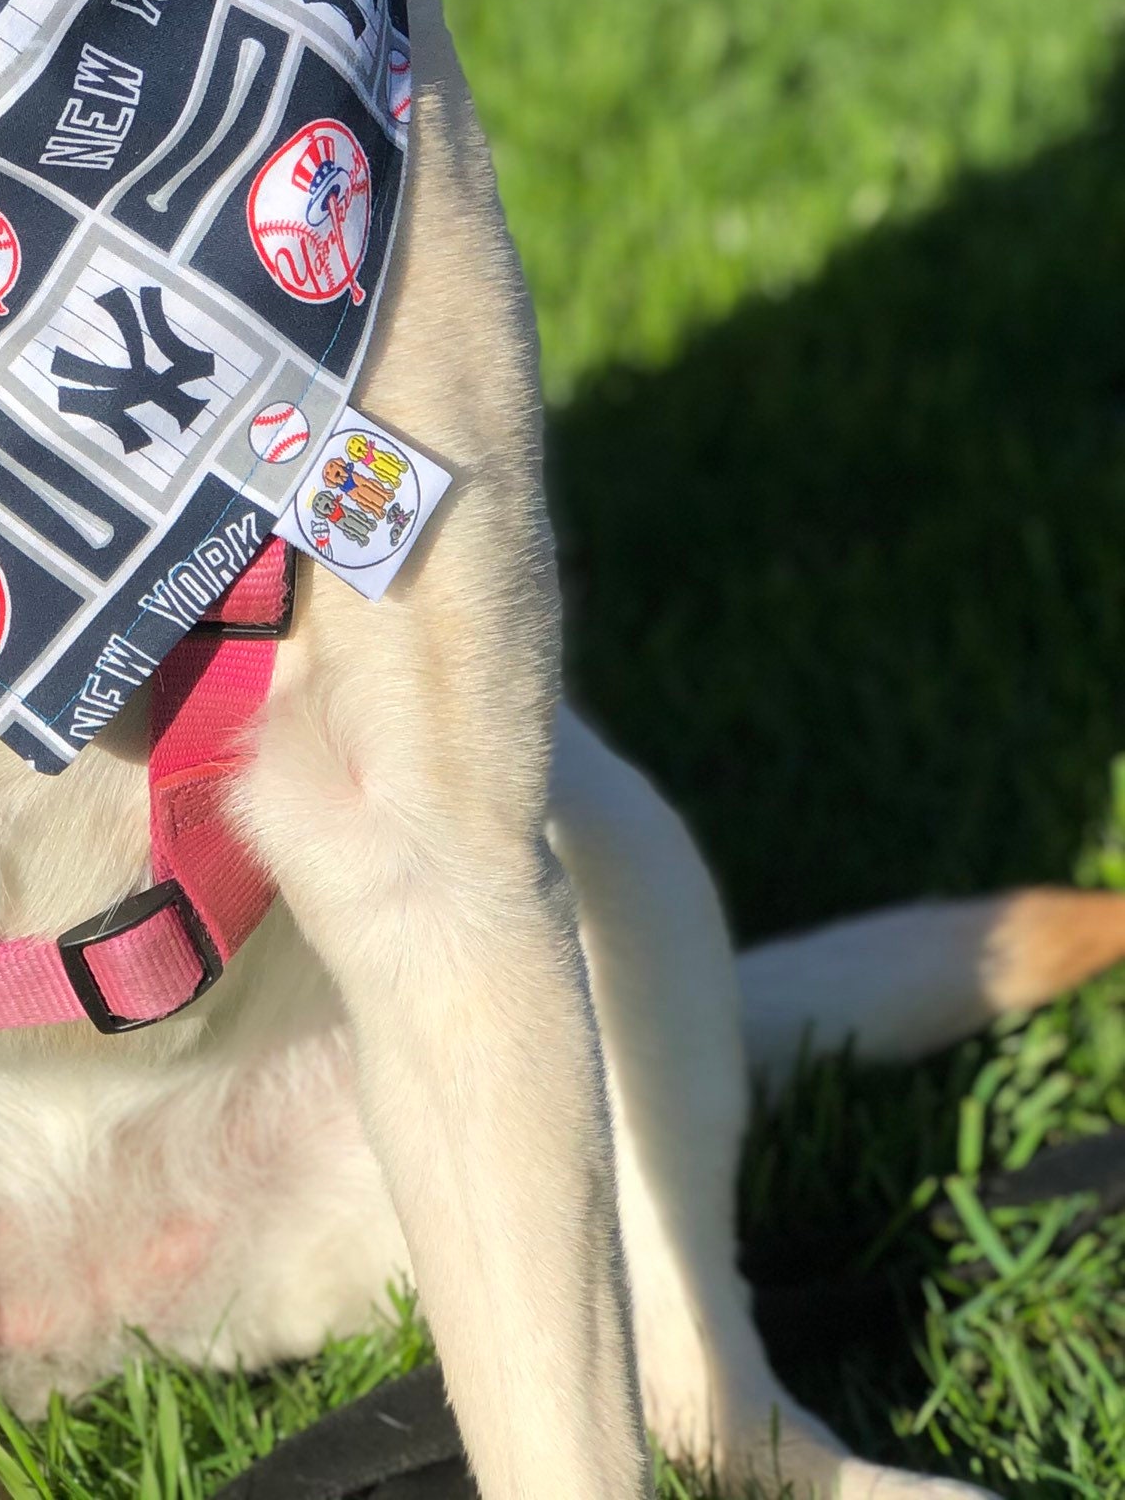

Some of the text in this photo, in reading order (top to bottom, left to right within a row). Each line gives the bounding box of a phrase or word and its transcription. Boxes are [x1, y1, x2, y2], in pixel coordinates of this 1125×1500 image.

[38, 42, 144, 171] NEW
[69, 511, 262, 741] NEW YORK
